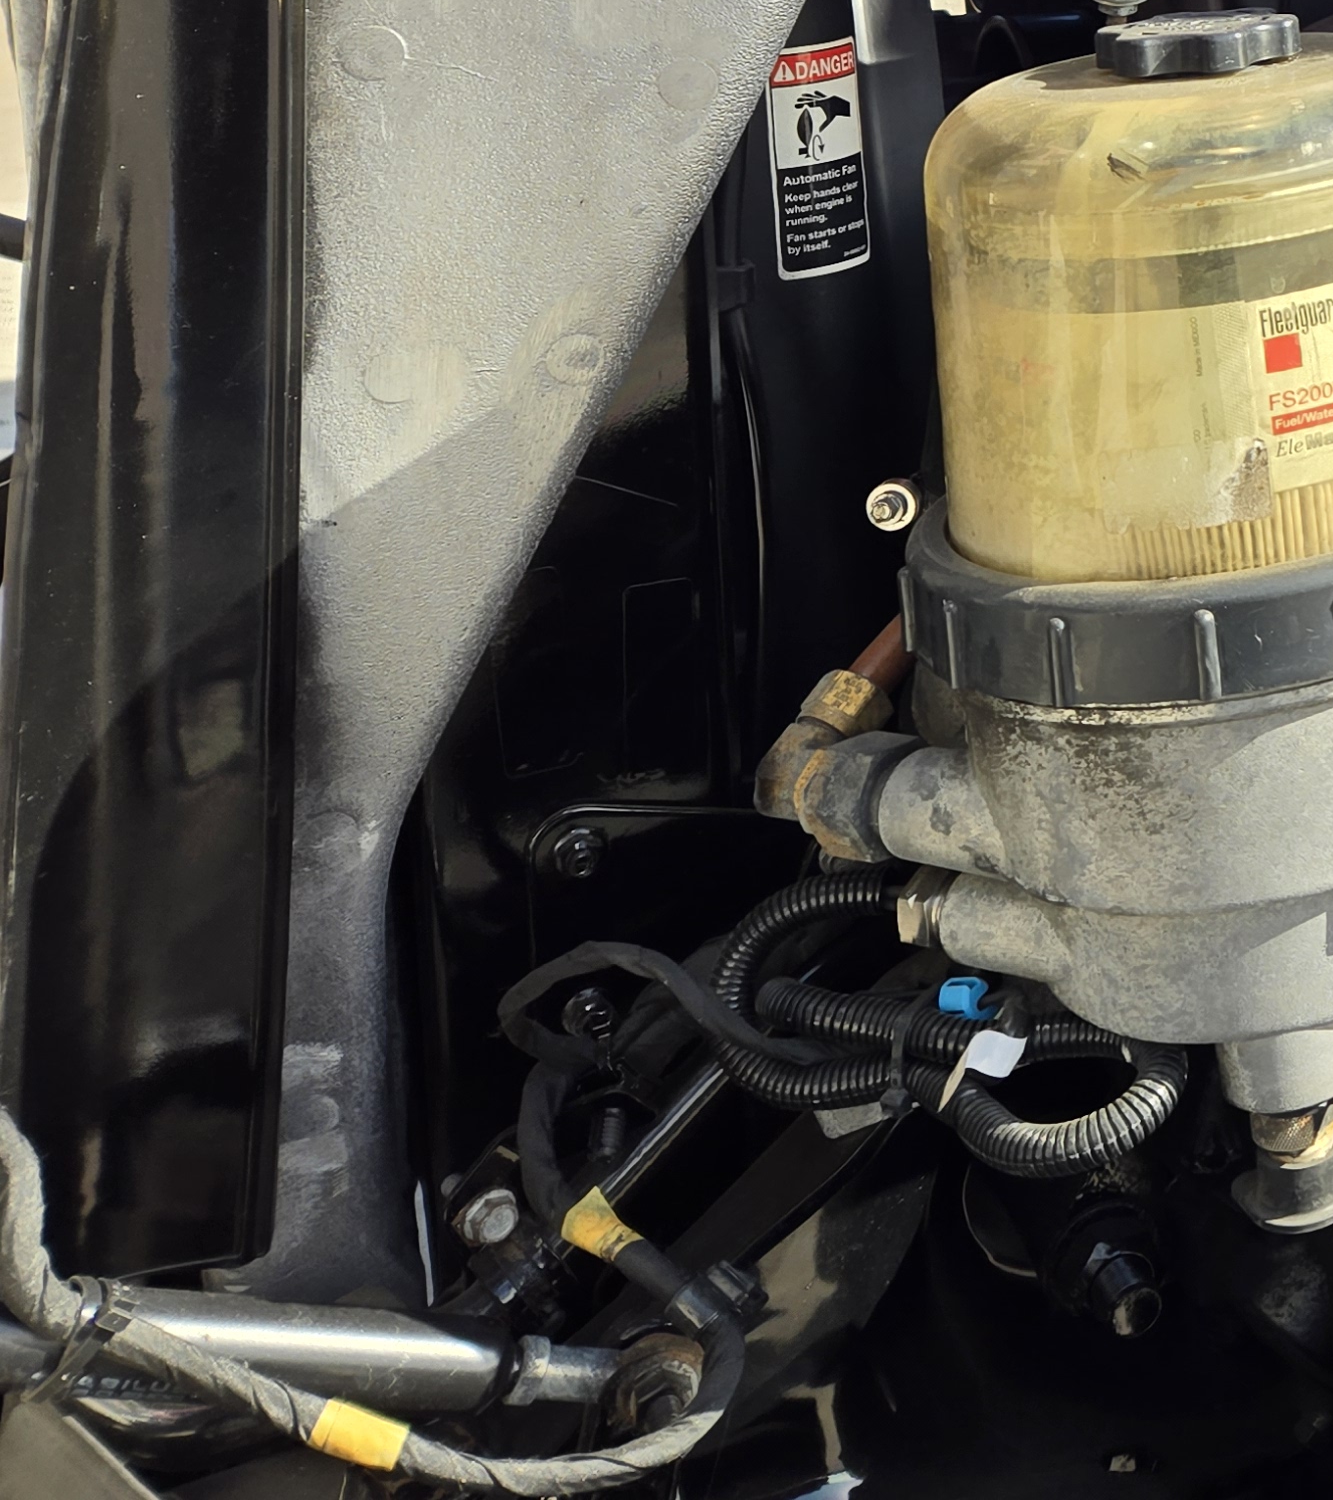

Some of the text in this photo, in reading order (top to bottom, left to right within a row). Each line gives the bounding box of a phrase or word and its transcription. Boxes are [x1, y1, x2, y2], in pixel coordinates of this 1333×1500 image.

[795, 51, 855, 80] DANGER
[783, 164, 857, 187] Automatic Fan
[784, 180, 859, 203] Keep hands clear
[784, 194, 852, 215] when engine is
[785, 214, 828, 227] running.
[786, 233, 806, 243] Fan
[807, 227, 837, 240] starts
[837, 225, 847, 234] or
[787, 245, 801, 256] by
[802, 239, 832, 253] itself.
